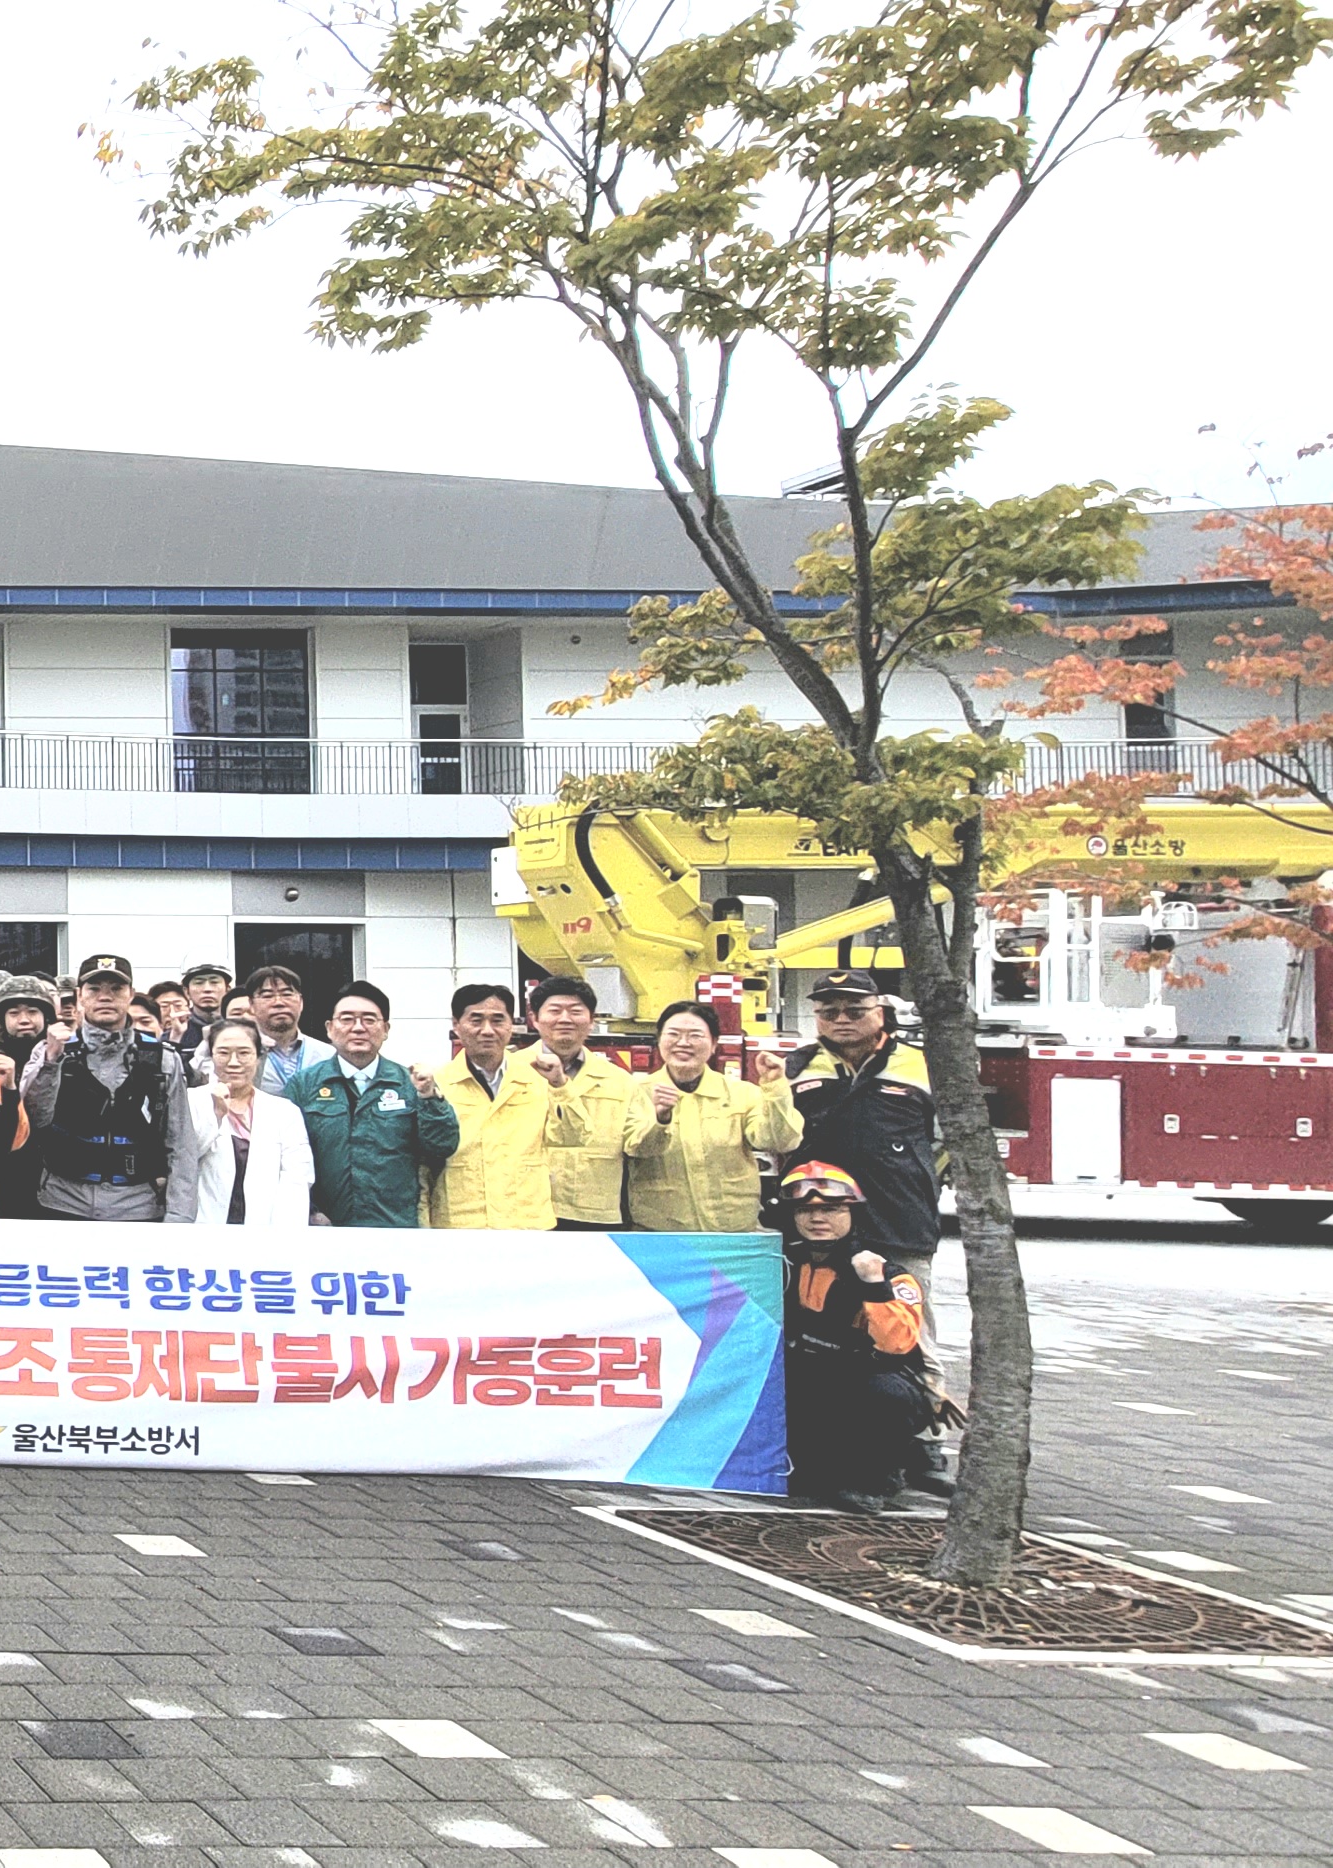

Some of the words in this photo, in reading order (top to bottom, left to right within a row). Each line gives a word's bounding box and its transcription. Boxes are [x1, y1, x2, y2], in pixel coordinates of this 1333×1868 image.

[1113, 838, 1186, 857] 울산소방
[563, 916, 592, 934] 119
[143, 1265, 298, 1316] 향상을
[311, 1270, 413, 1317] 위한
[68, 1328, 264, 1404] 통제단
[270, 1333, 399, 1404] 불시
[409, 1334, 664, 1409] 가동훈련
[12, 1423, 201, 1458] 울산북부소방서
